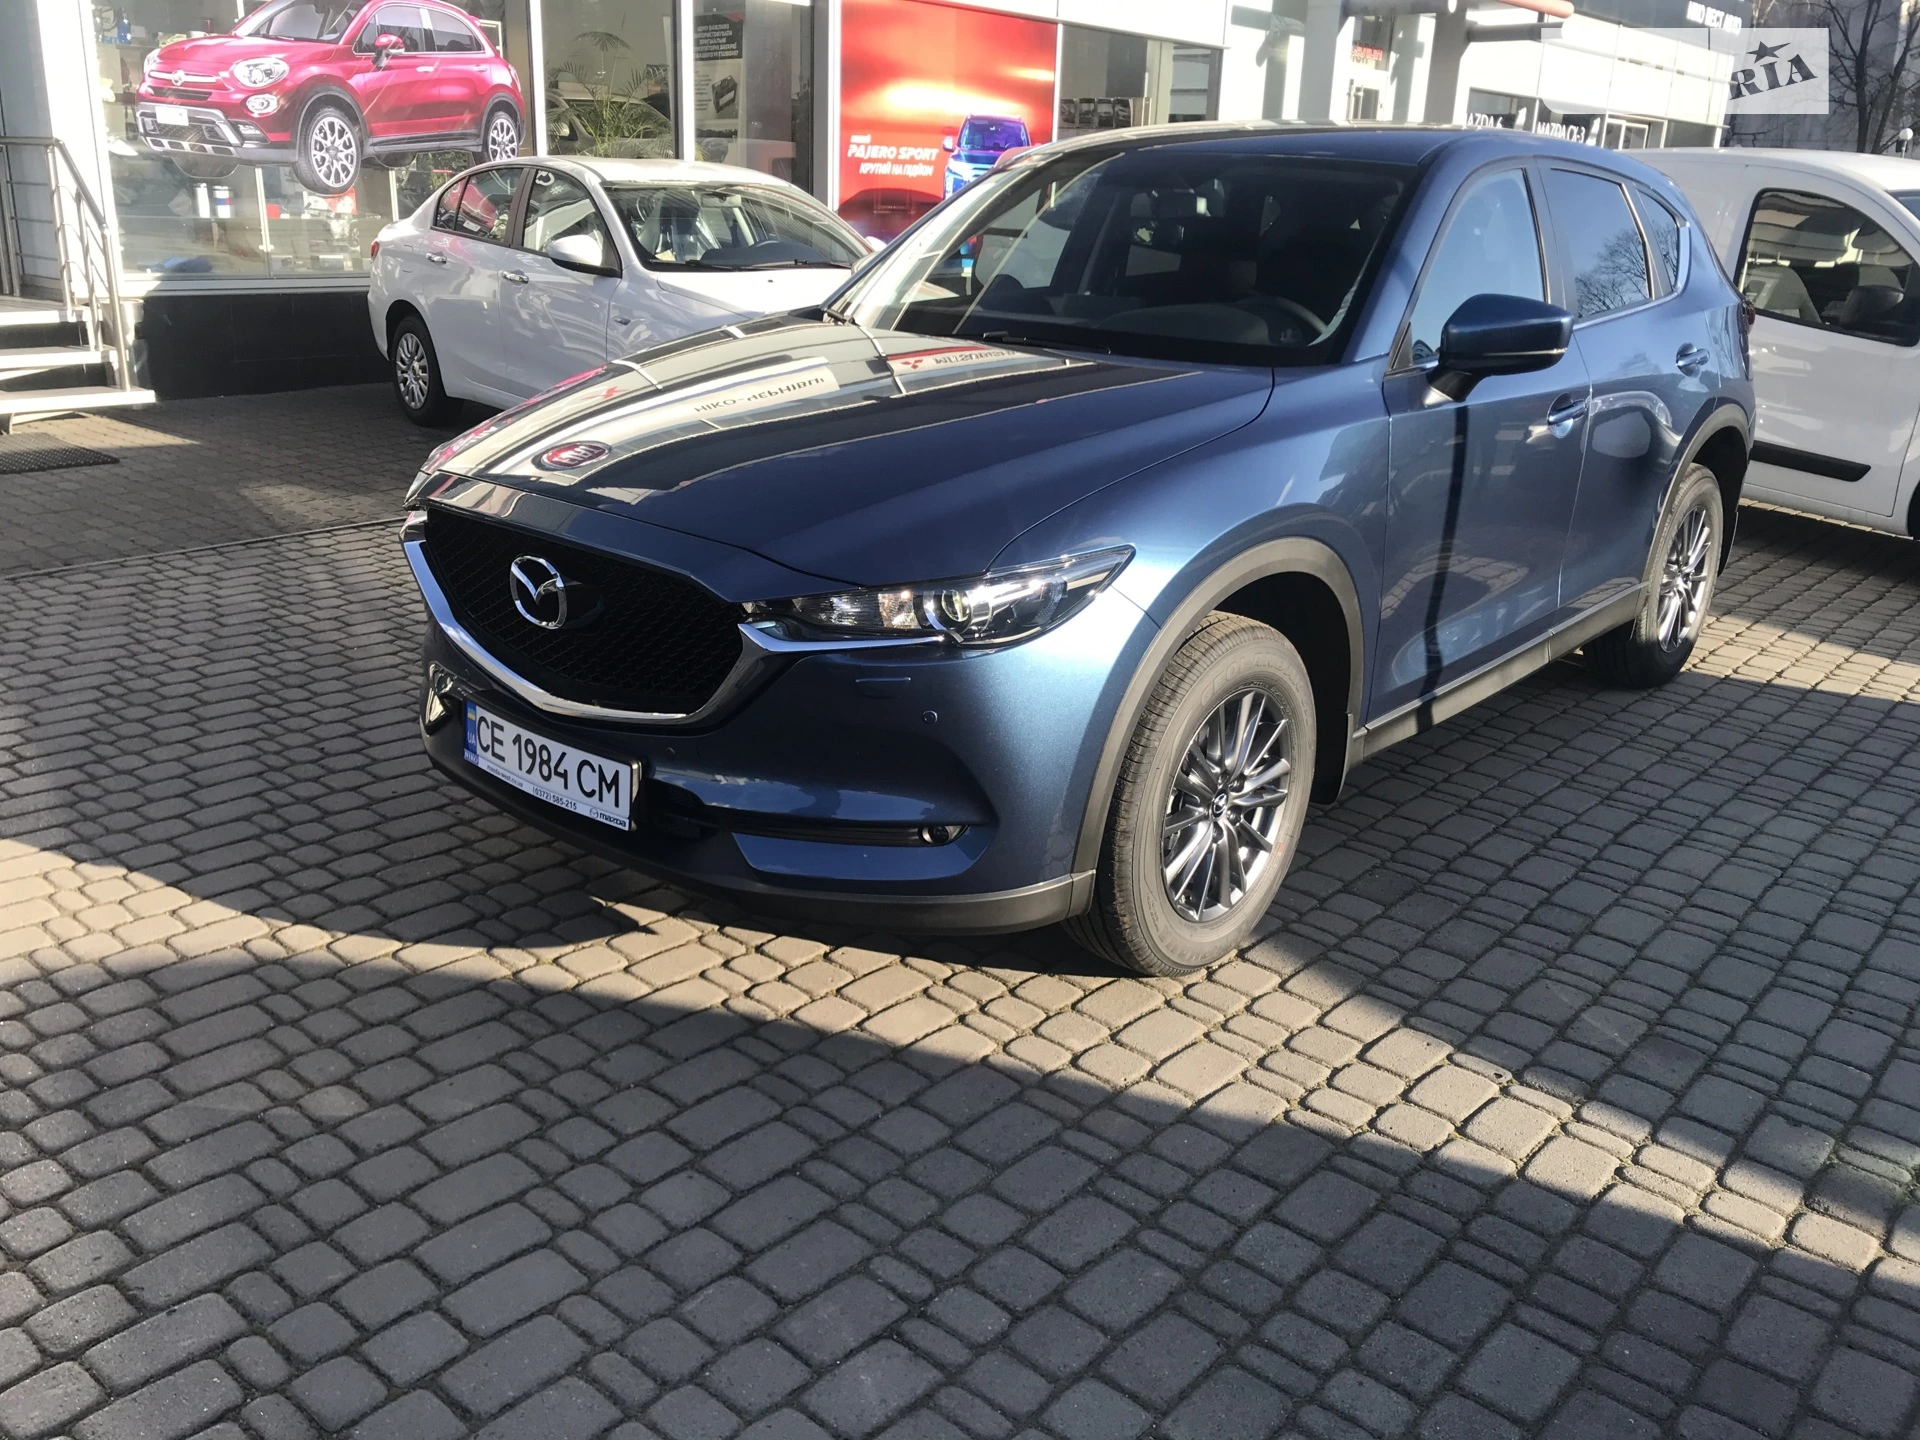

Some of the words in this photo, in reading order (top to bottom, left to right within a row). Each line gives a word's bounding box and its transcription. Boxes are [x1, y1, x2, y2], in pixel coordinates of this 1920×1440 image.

[1467, 113, 1494, 128] AZDA
[1537, 121, 1566, 139] MAZDA
[1567, 124, 1586, 143] CX-3
[847, 144, 897, 160] PAJERO
[898, 146, 939, 161] SPORT
[859, 161, 892, 175] КРУТИЙ
[892, 163, 903, 175] НА
[467, 732, 476, 744] UA
[477, 716, 505, 763] CE
[512, 734, 568, 790] 1984
[577, 759, 620, 808] CM
[552, 794, 578, 811] 585-215
[599, 813, 627, 828] mazda
